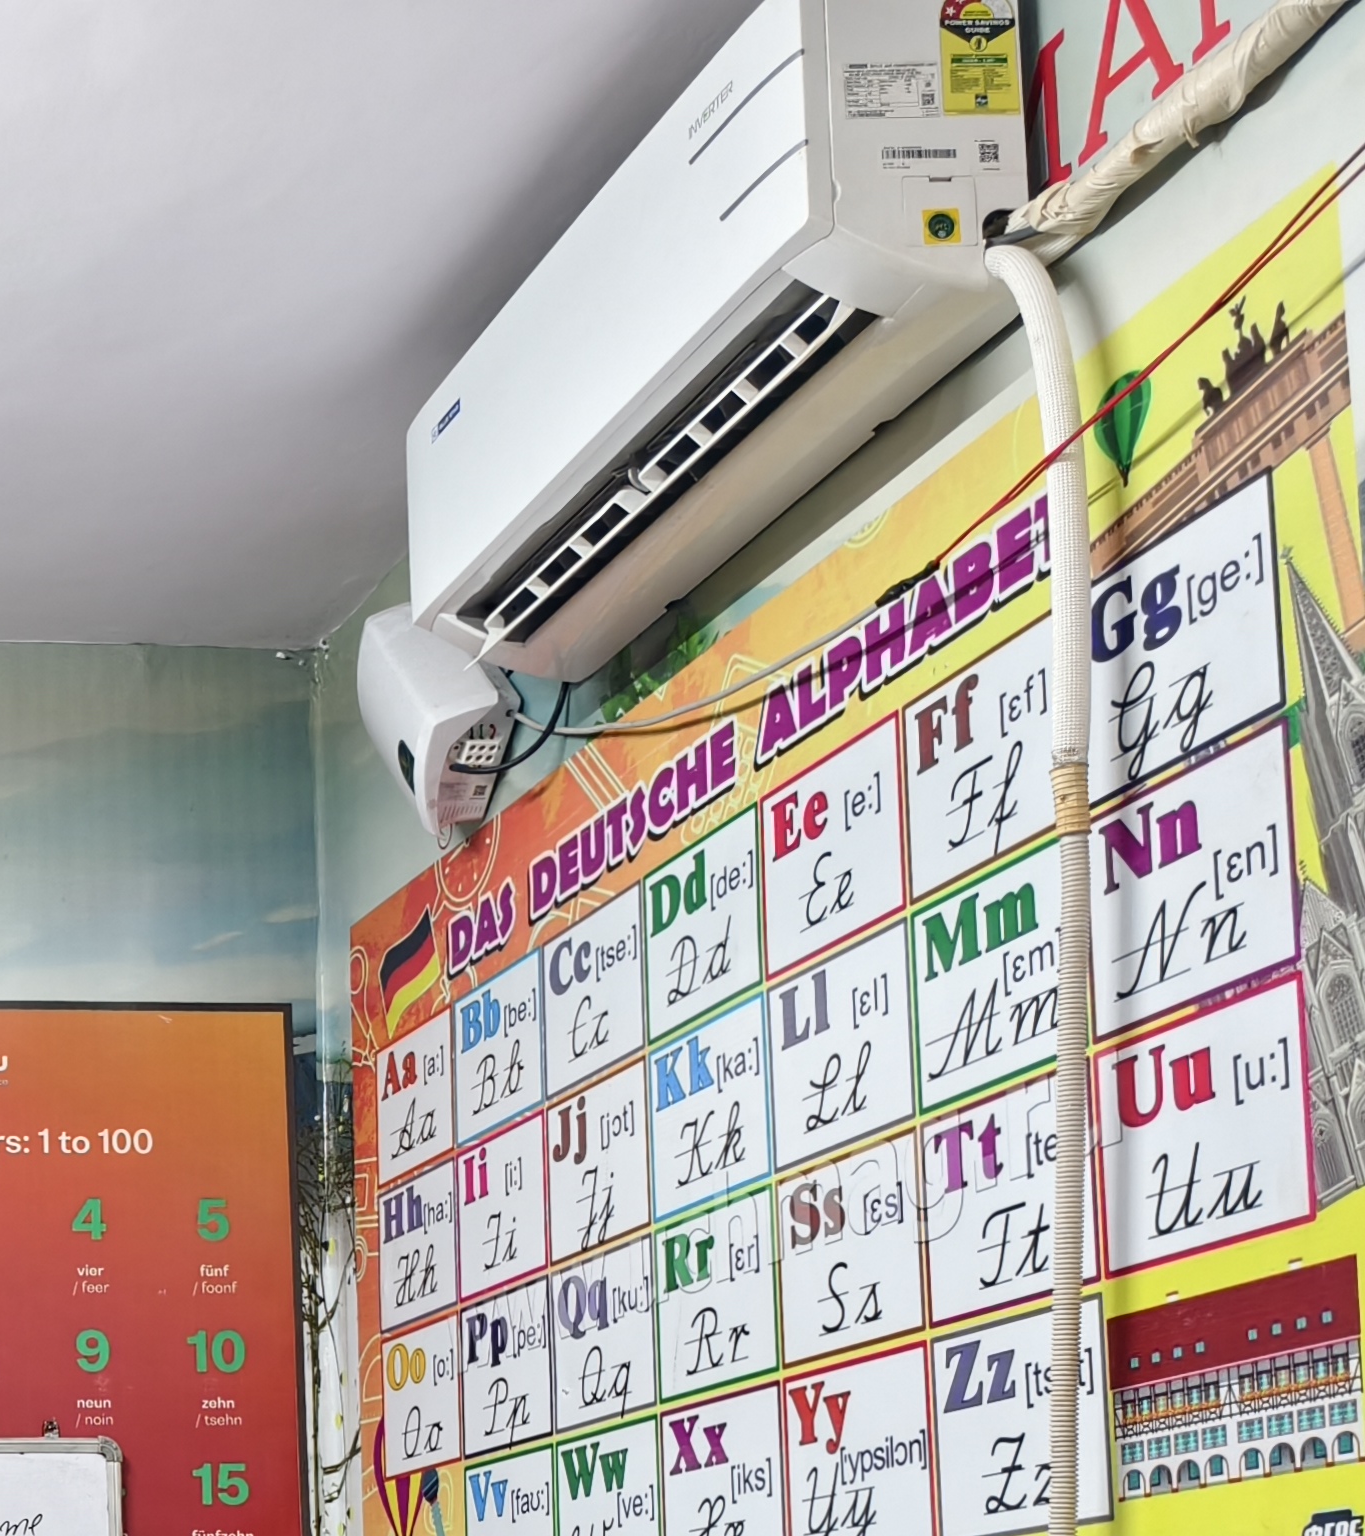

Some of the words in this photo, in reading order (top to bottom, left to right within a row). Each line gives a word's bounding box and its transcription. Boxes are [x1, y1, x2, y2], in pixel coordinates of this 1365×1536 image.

[689, 80, 733, 140] INVERTER
[1092, 565, 1182, 662] Gg
[914, 674, 979, 776] Ff
[447, 893, 516, 976] DAS
[530, 721, 738, 924] DEUTSCHE
[771, 790, 828, 862] Ee
[1098, 800, 1202, 895] Nn
[649, 849, 707, 937] Dd
[923, 882, 1039, 982] Mm
[549, 937, 592, 996] Cc
[460, 989, 501, 1054] Bb
[381, 1051, 417, 1101] Aa
[1113, 1044, 1215, 1127] Uu
[38, 1130, 51, 1155] 1
[59, 1130, 91, 1155] to
[98, 1129, 154, 1155] 100
[934, 1113, 1003, 1194] Tt
[72, 1198, 107, 1241] 4
[197, 1198, 230, 1241] 5
[789, 1181, 845, 1249] Ss
[77, 1265, 104, 1277] vier
[200, 1265, 229, 1277] fünf
[75, 1329, 110, 1372] 9
[186, 1330, 246, 1373] 10
[77, 1399, 111, 1409] neun
[202, 1397, 235, 1409] zehn
[192, 1463, 249, 1505] 15
